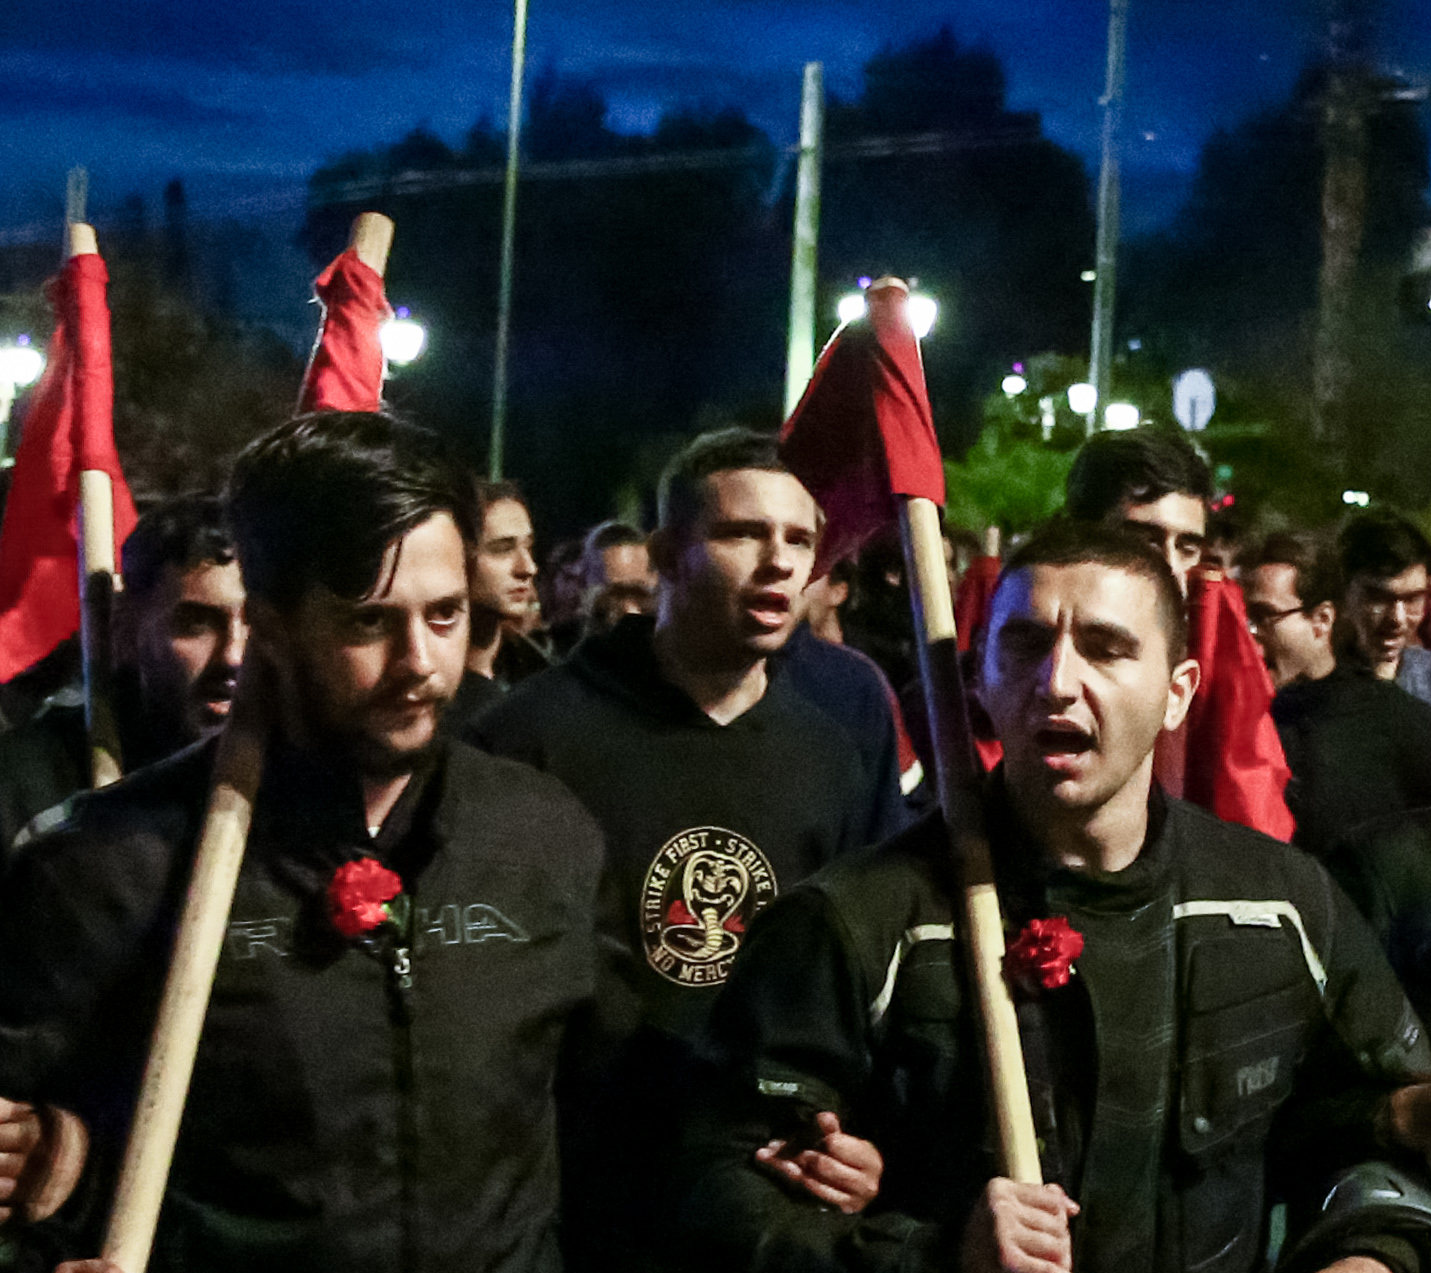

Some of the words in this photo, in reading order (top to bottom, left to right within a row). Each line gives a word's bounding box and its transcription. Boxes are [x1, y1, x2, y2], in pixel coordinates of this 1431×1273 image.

[645, 863, 671, 933] STRIKE
[665, 832, 709, 864] FIRST
[725, 838, 772, 892] STRIKE
[652, 946, 676, 971] NO
